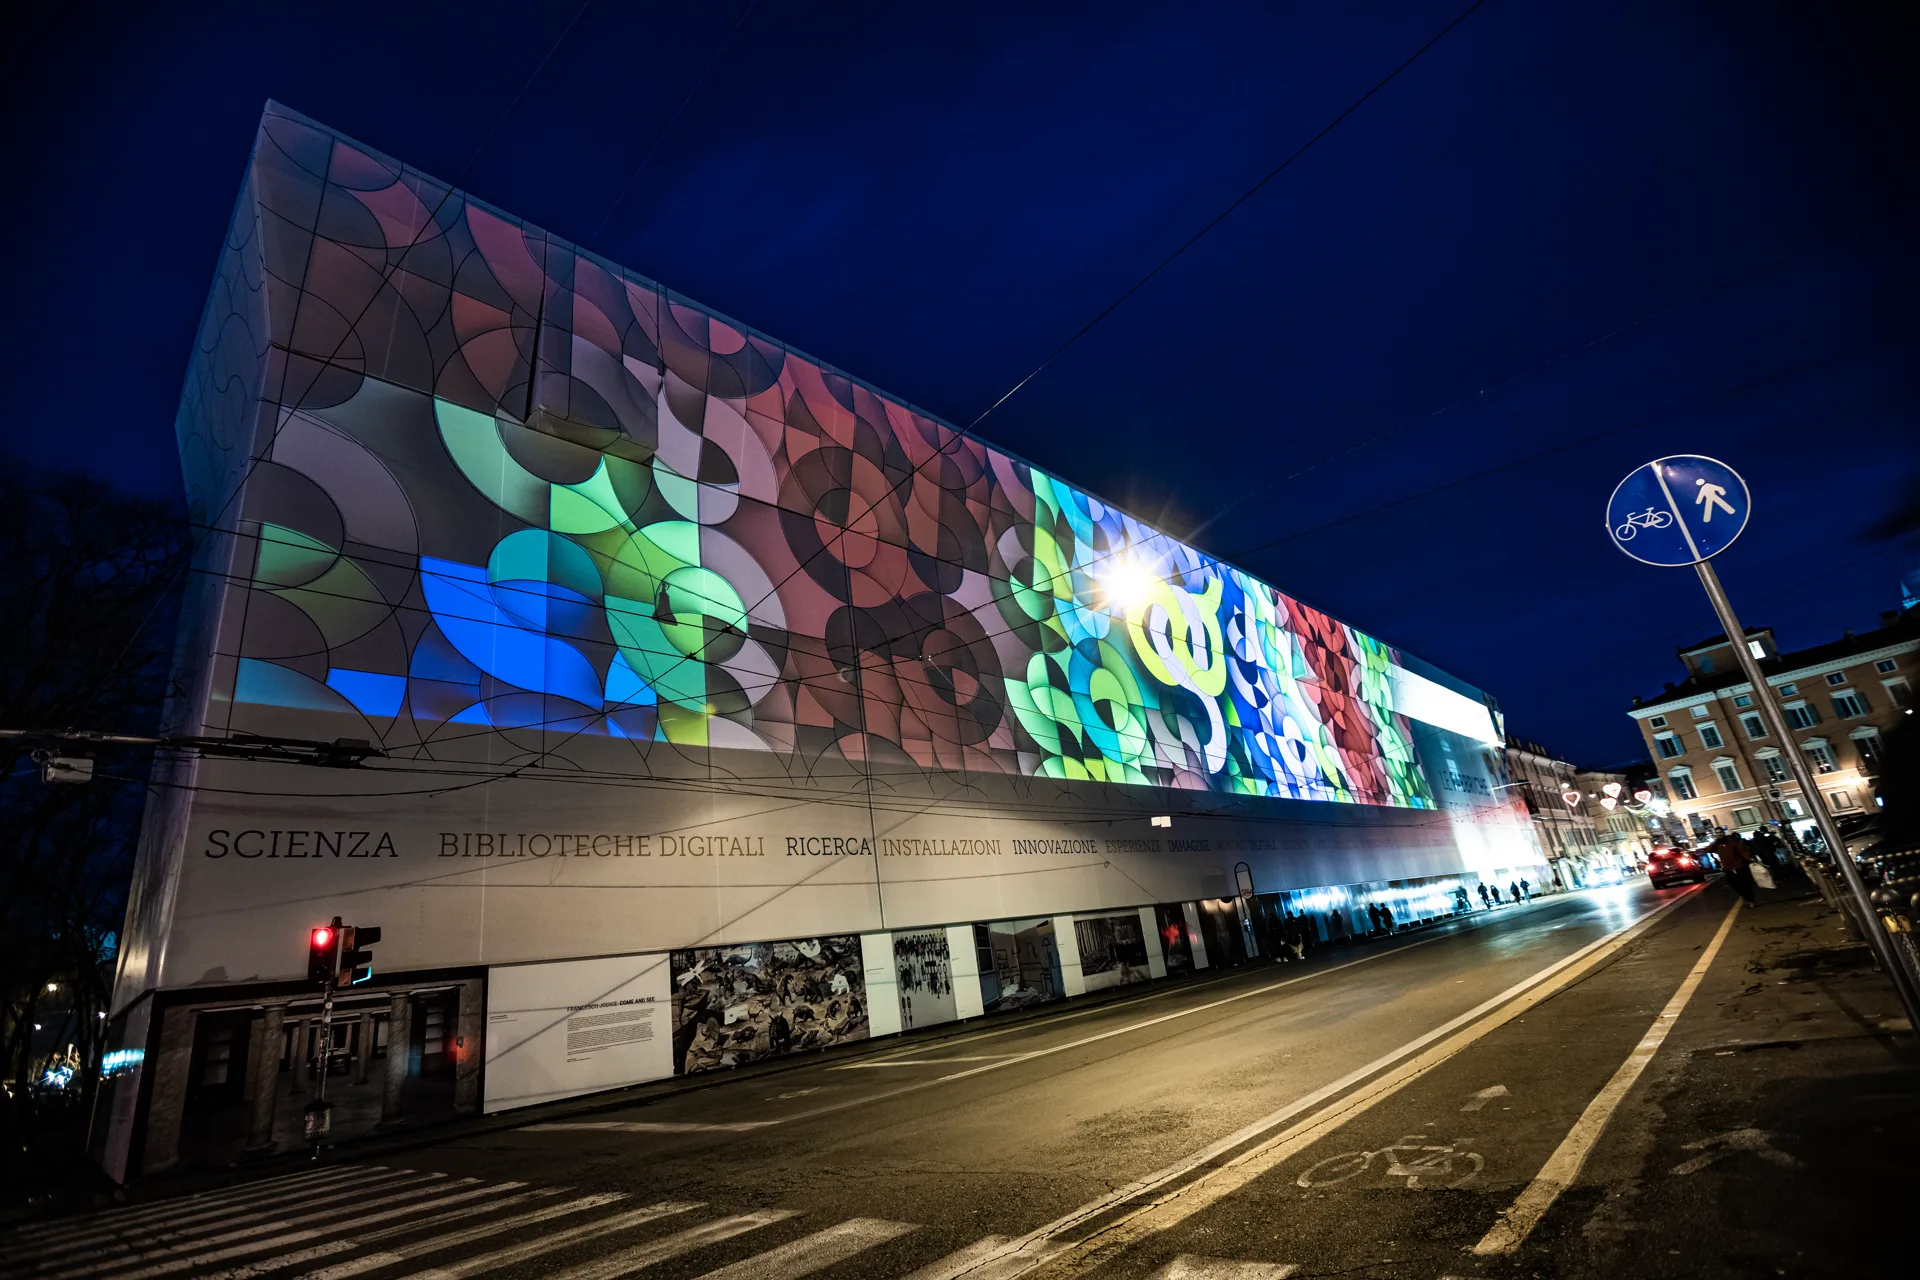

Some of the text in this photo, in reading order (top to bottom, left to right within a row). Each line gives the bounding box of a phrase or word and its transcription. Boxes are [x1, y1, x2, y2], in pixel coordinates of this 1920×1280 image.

[204, 829, 399, 859] SCIENZA
[438, 832, 652, 858] BIBLIOTECHE
[659, 835, 766, 857] DIGITALI
[785, 836, 873, 857] RICERCA
[883, 838, 1001, 857] INSTALLAZIONI
[1012, 839, 1098, 855] INNOVAZIONE
[1104, 839, 1162, 854] ESPERIENZE
[1168, 839, 1211, 852] IMMAGINE
[566, 1003, 599, 1012] FRANCESCO
[619, 998, 634, 1006] COME
